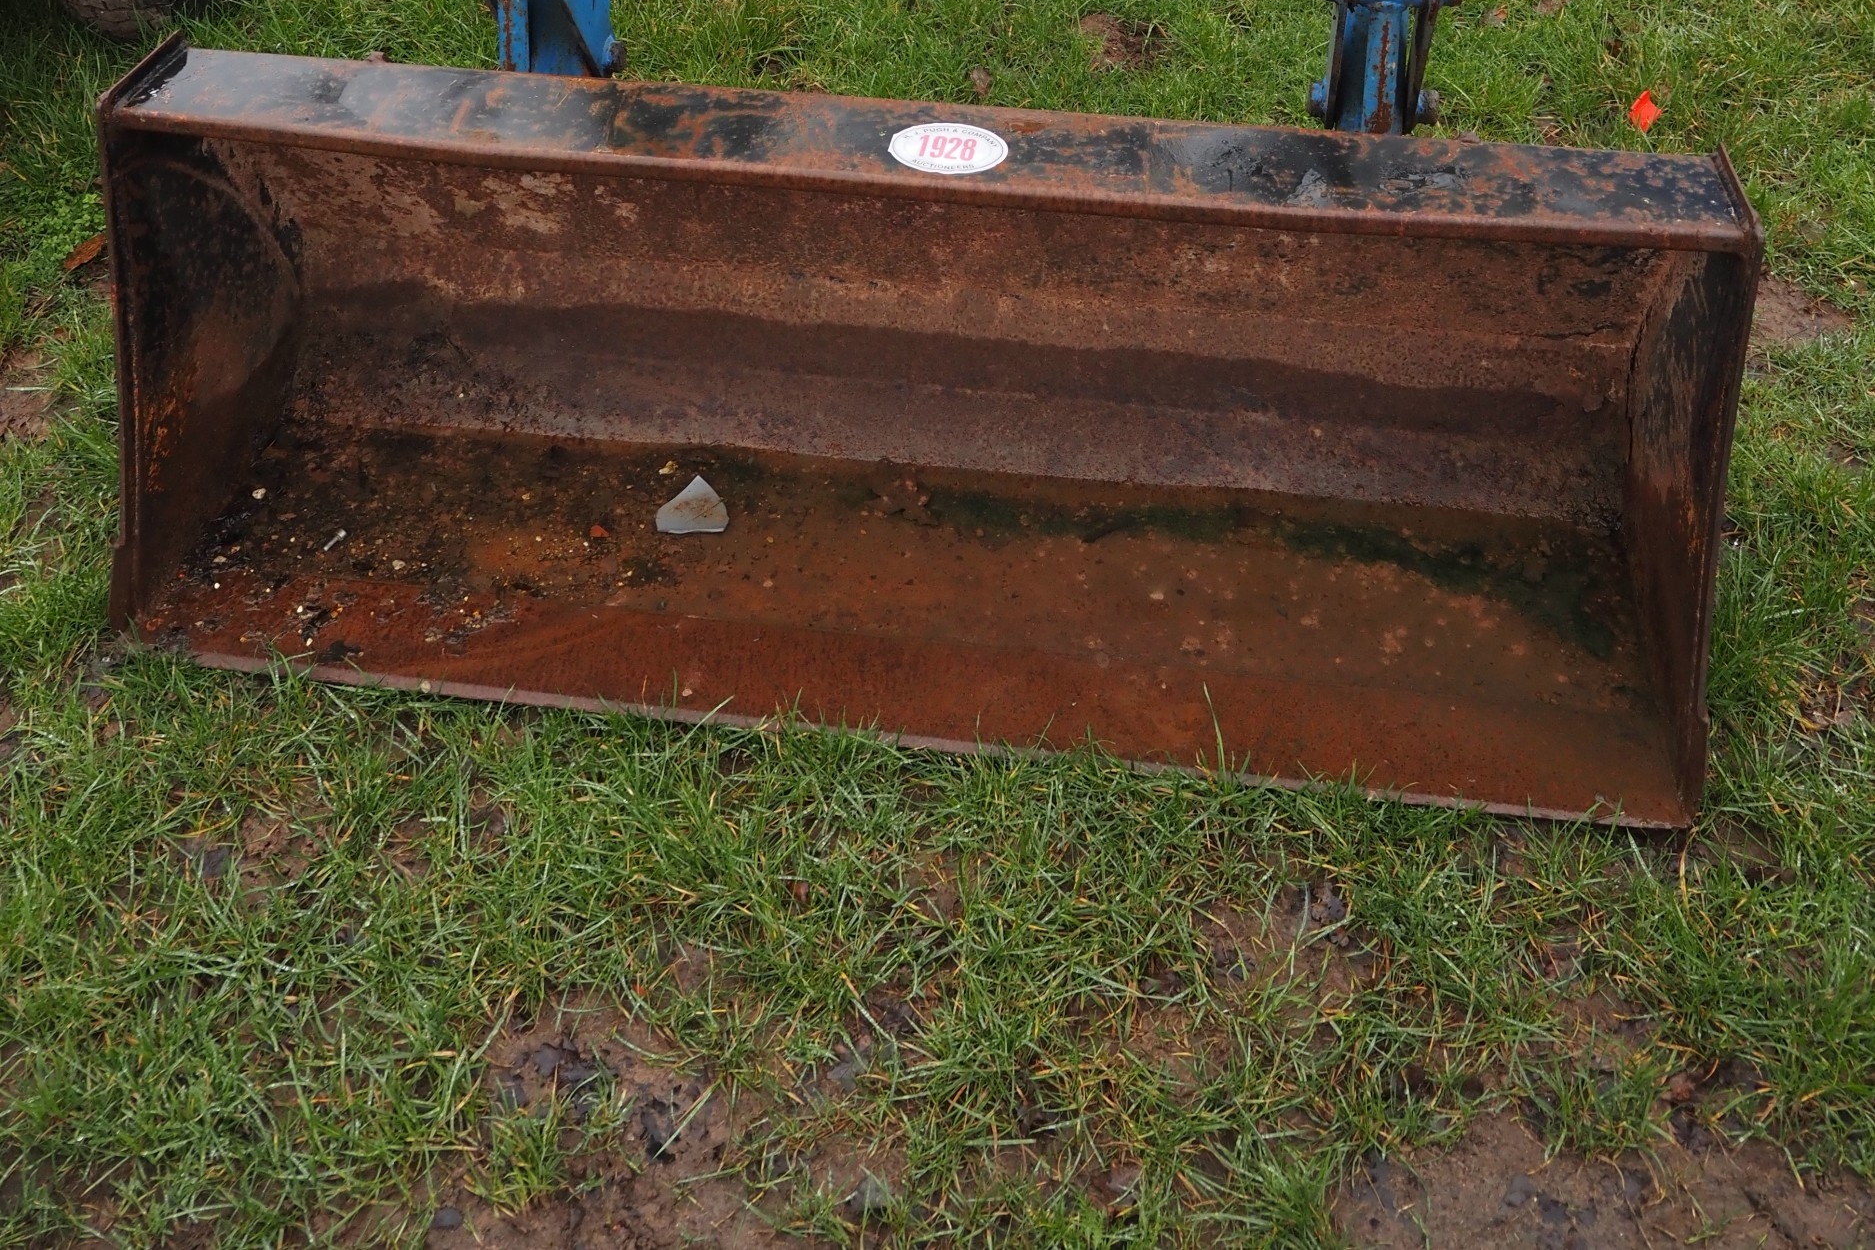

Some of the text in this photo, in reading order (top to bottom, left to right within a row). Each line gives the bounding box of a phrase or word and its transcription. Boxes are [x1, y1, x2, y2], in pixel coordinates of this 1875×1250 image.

[918, 134, 977, 161] 1928
[961, 129, 999, 148] COMPANY
[911, 158, 975, 170] AUCTIONEERS
